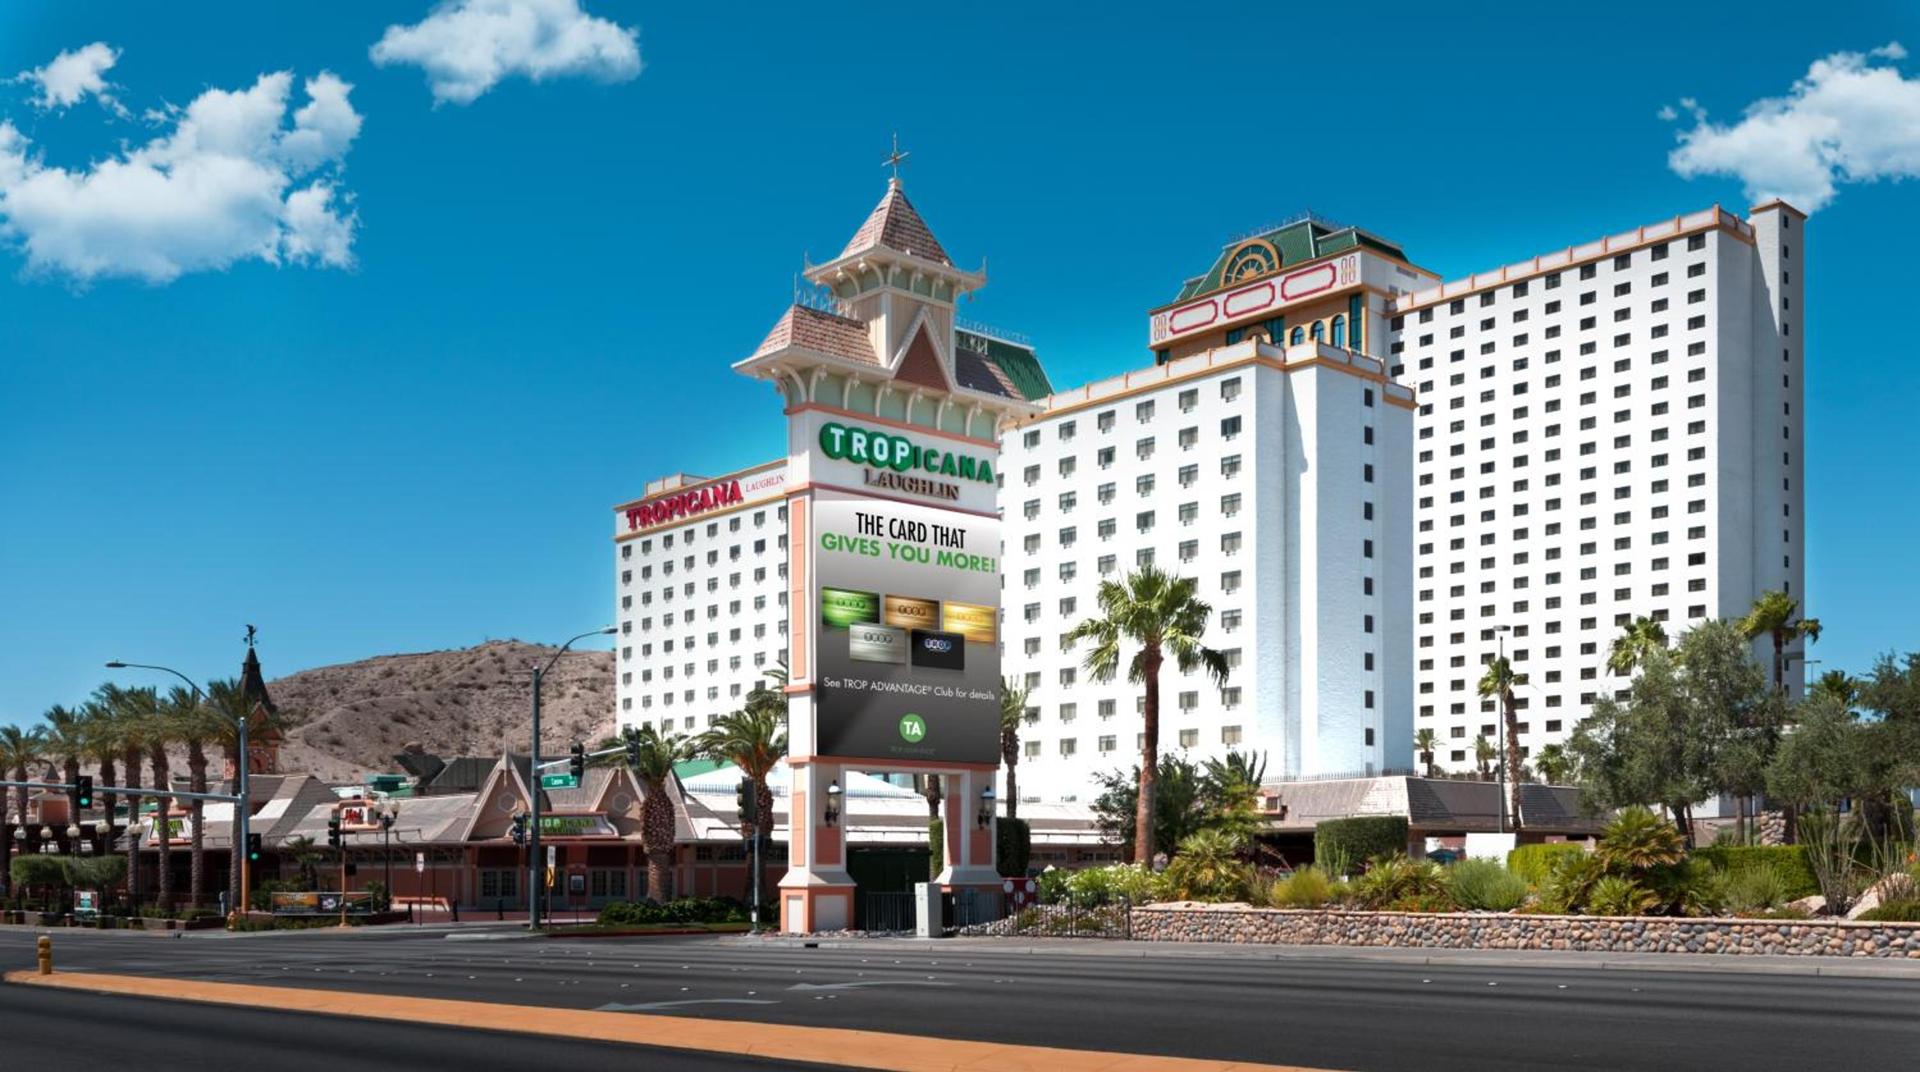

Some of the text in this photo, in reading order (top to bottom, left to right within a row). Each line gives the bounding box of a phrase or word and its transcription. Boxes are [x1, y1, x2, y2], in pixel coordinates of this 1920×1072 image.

[820, 422, 994, 483] TROPICANA
[745, 473, 786, 493] LAUGHLIN
[863, 467, 960, 500] LAUGHLIN
[626, 479, 744, 530] TROPICANA
[855, 512, 966, 549] THE CARD THAT
[820, 532, 996, 573] GIVES YOU MORE!
[823, 677, 841, 688] See
[843, 678, 868, 690] TROP
[934, 686, 953, 697] Club
[955, 688, 966, 698] for
[969, 689, 995, 700] details
[903, 721, 922, 736] TA
